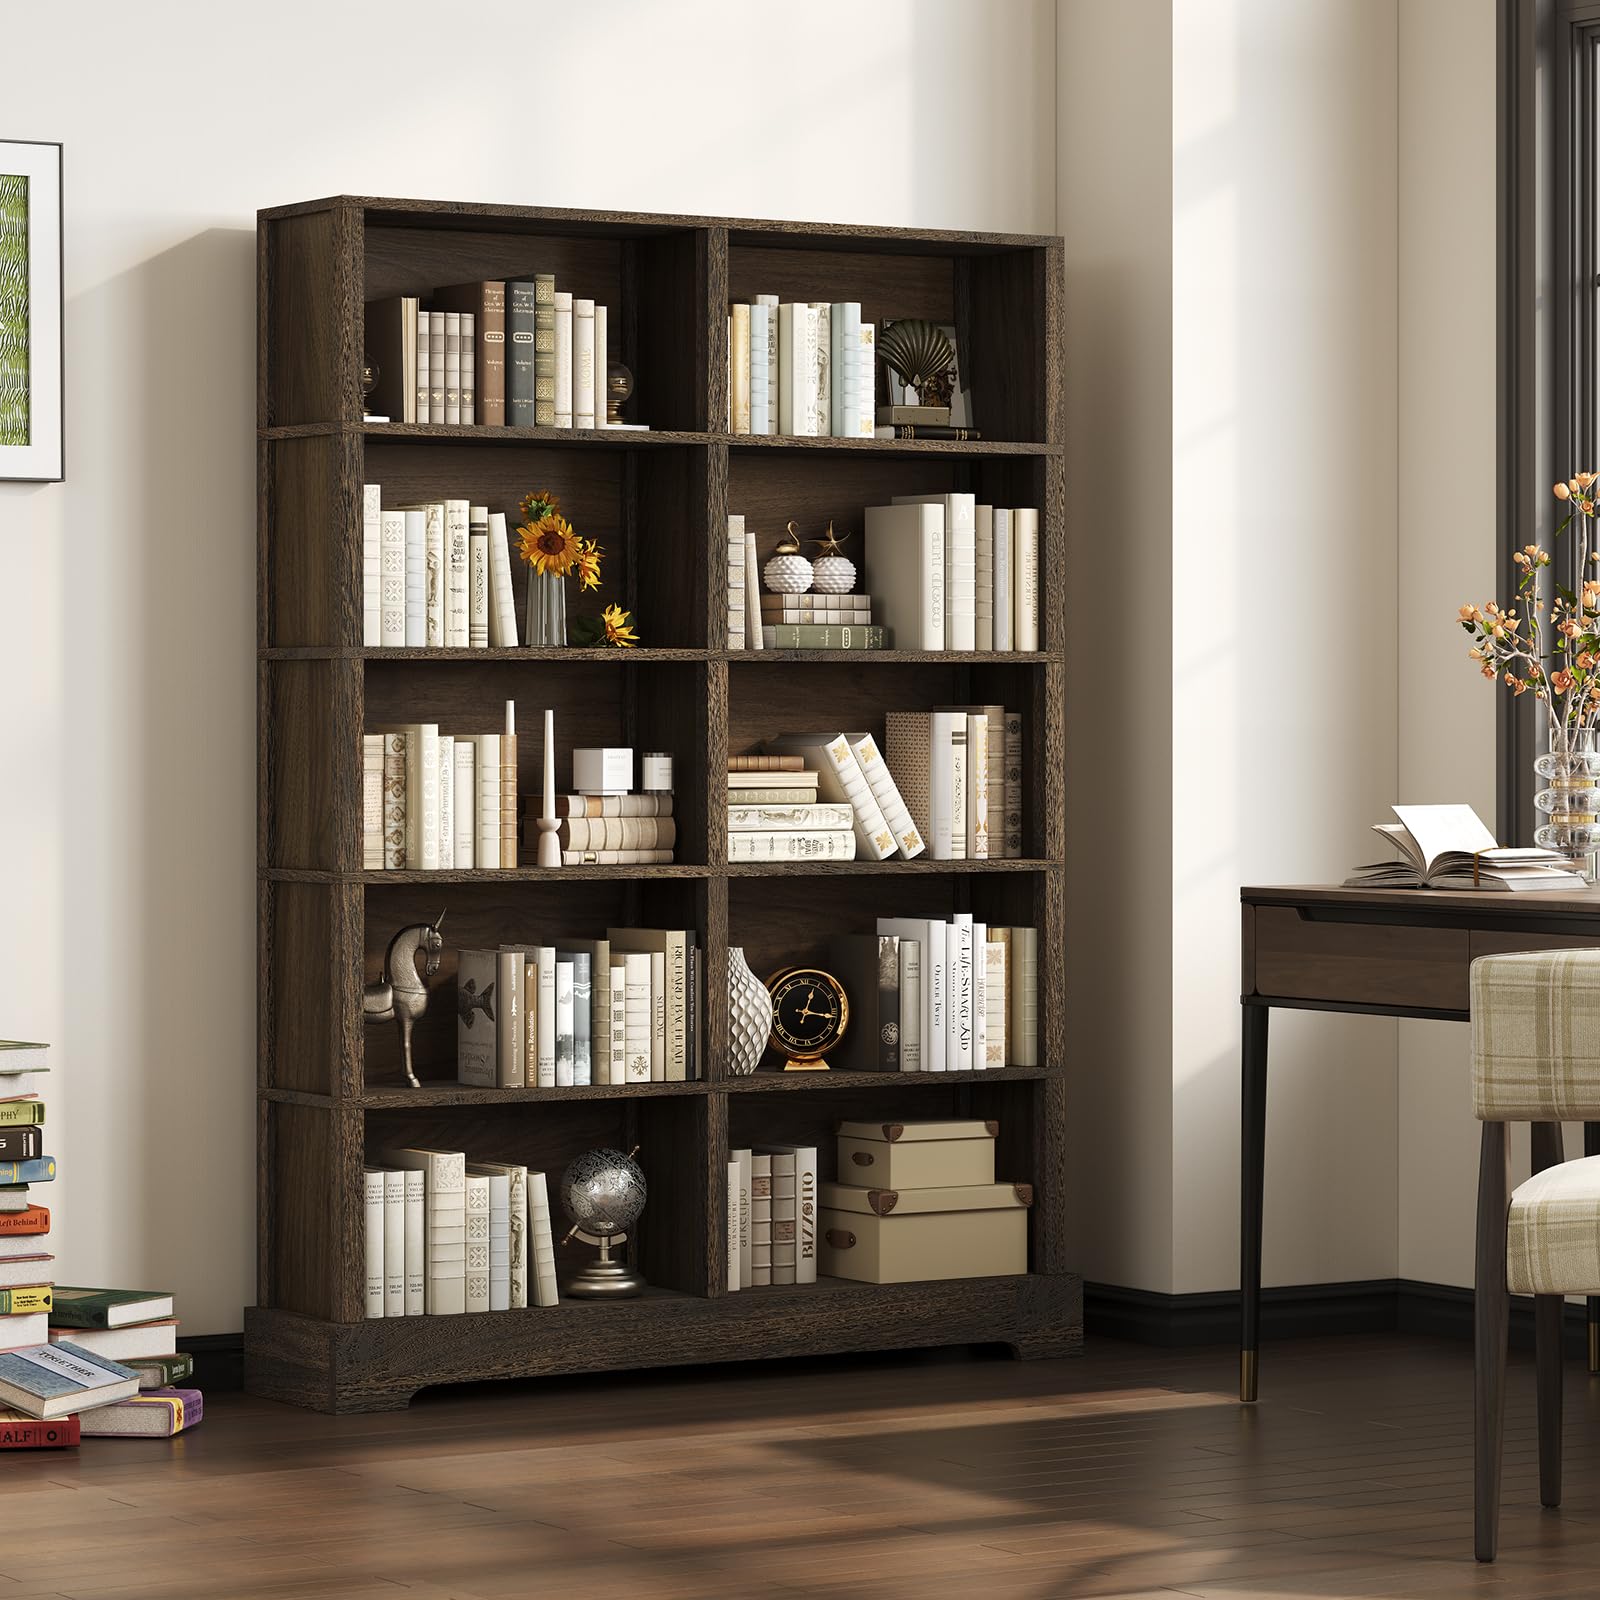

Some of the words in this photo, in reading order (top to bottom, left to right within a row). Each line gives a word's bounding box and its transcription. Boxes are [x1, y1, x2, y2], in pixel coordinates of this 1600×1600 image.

[675, 945, 683, 1000] RICHARD
[656, 995, 664, 1040] TACITUS
[13, 1218, 38, 1226] Behind
[39, 1350, 95, 1377] TOGETHER
[0, 1429, 32, 1443] ALF
